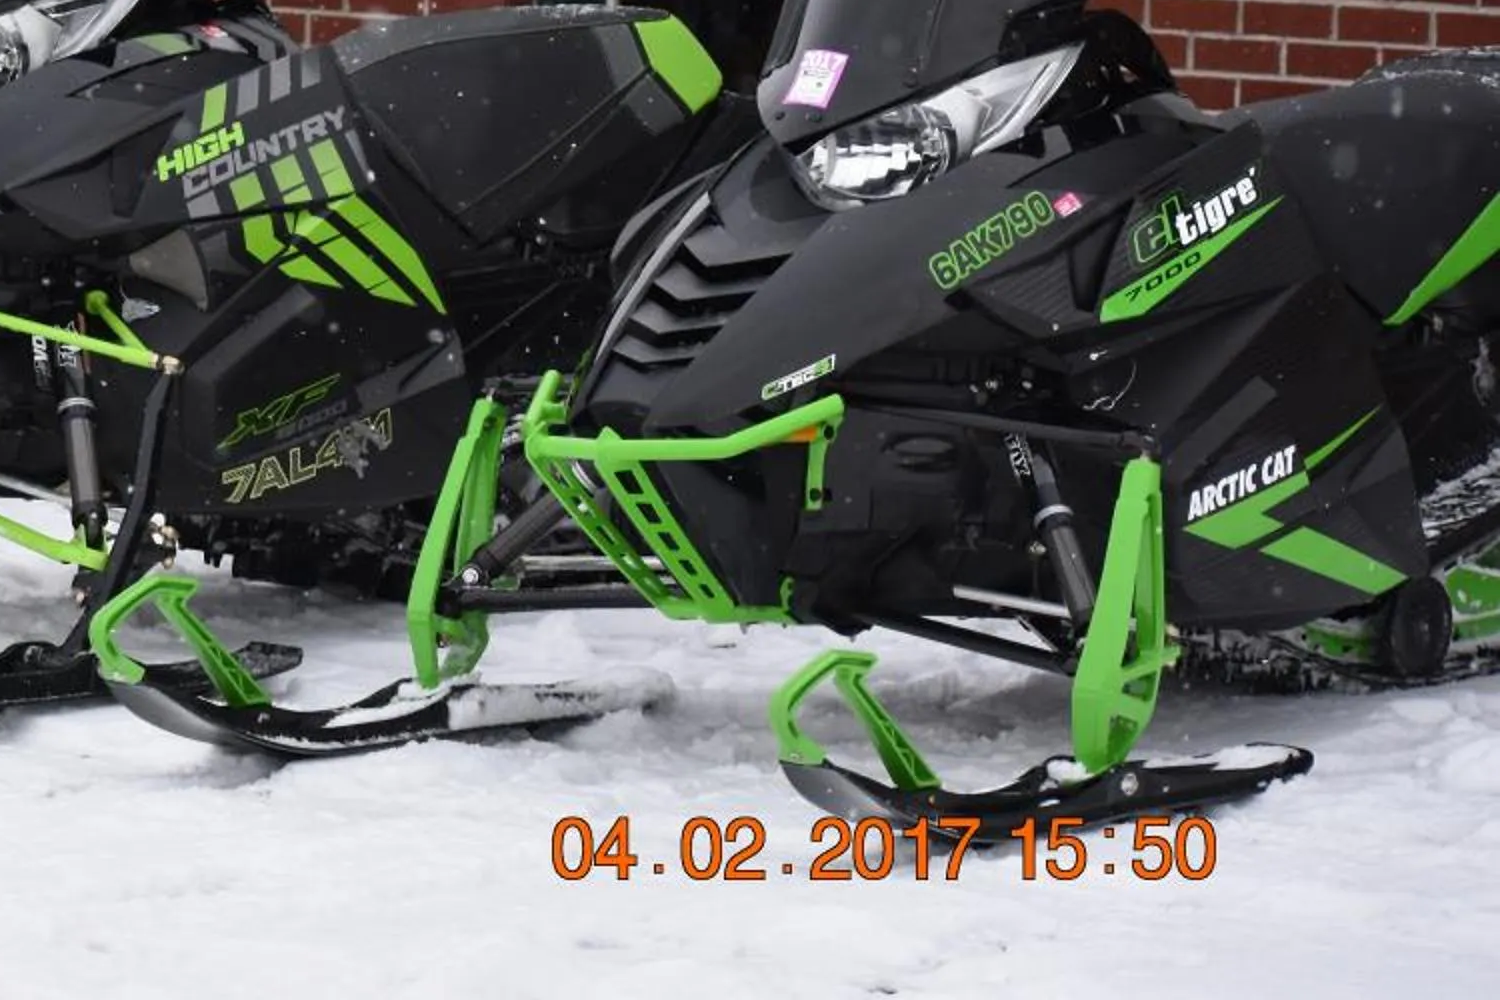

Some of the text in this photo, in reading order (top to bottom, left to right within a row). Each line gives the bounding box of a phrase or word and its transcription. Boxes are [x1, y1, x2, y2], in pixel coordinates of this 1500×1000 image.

[801, 50, 848, 71] 2017
[156, 121, 246, 182] HIGH
[182, 105, 345, 199] COUNTRY
[928, 190, 1055, 290] 6AK790
[1124, 251, 1201, 303] 7000
[1187, 444, 1297, 521] ARCTIC CAT
